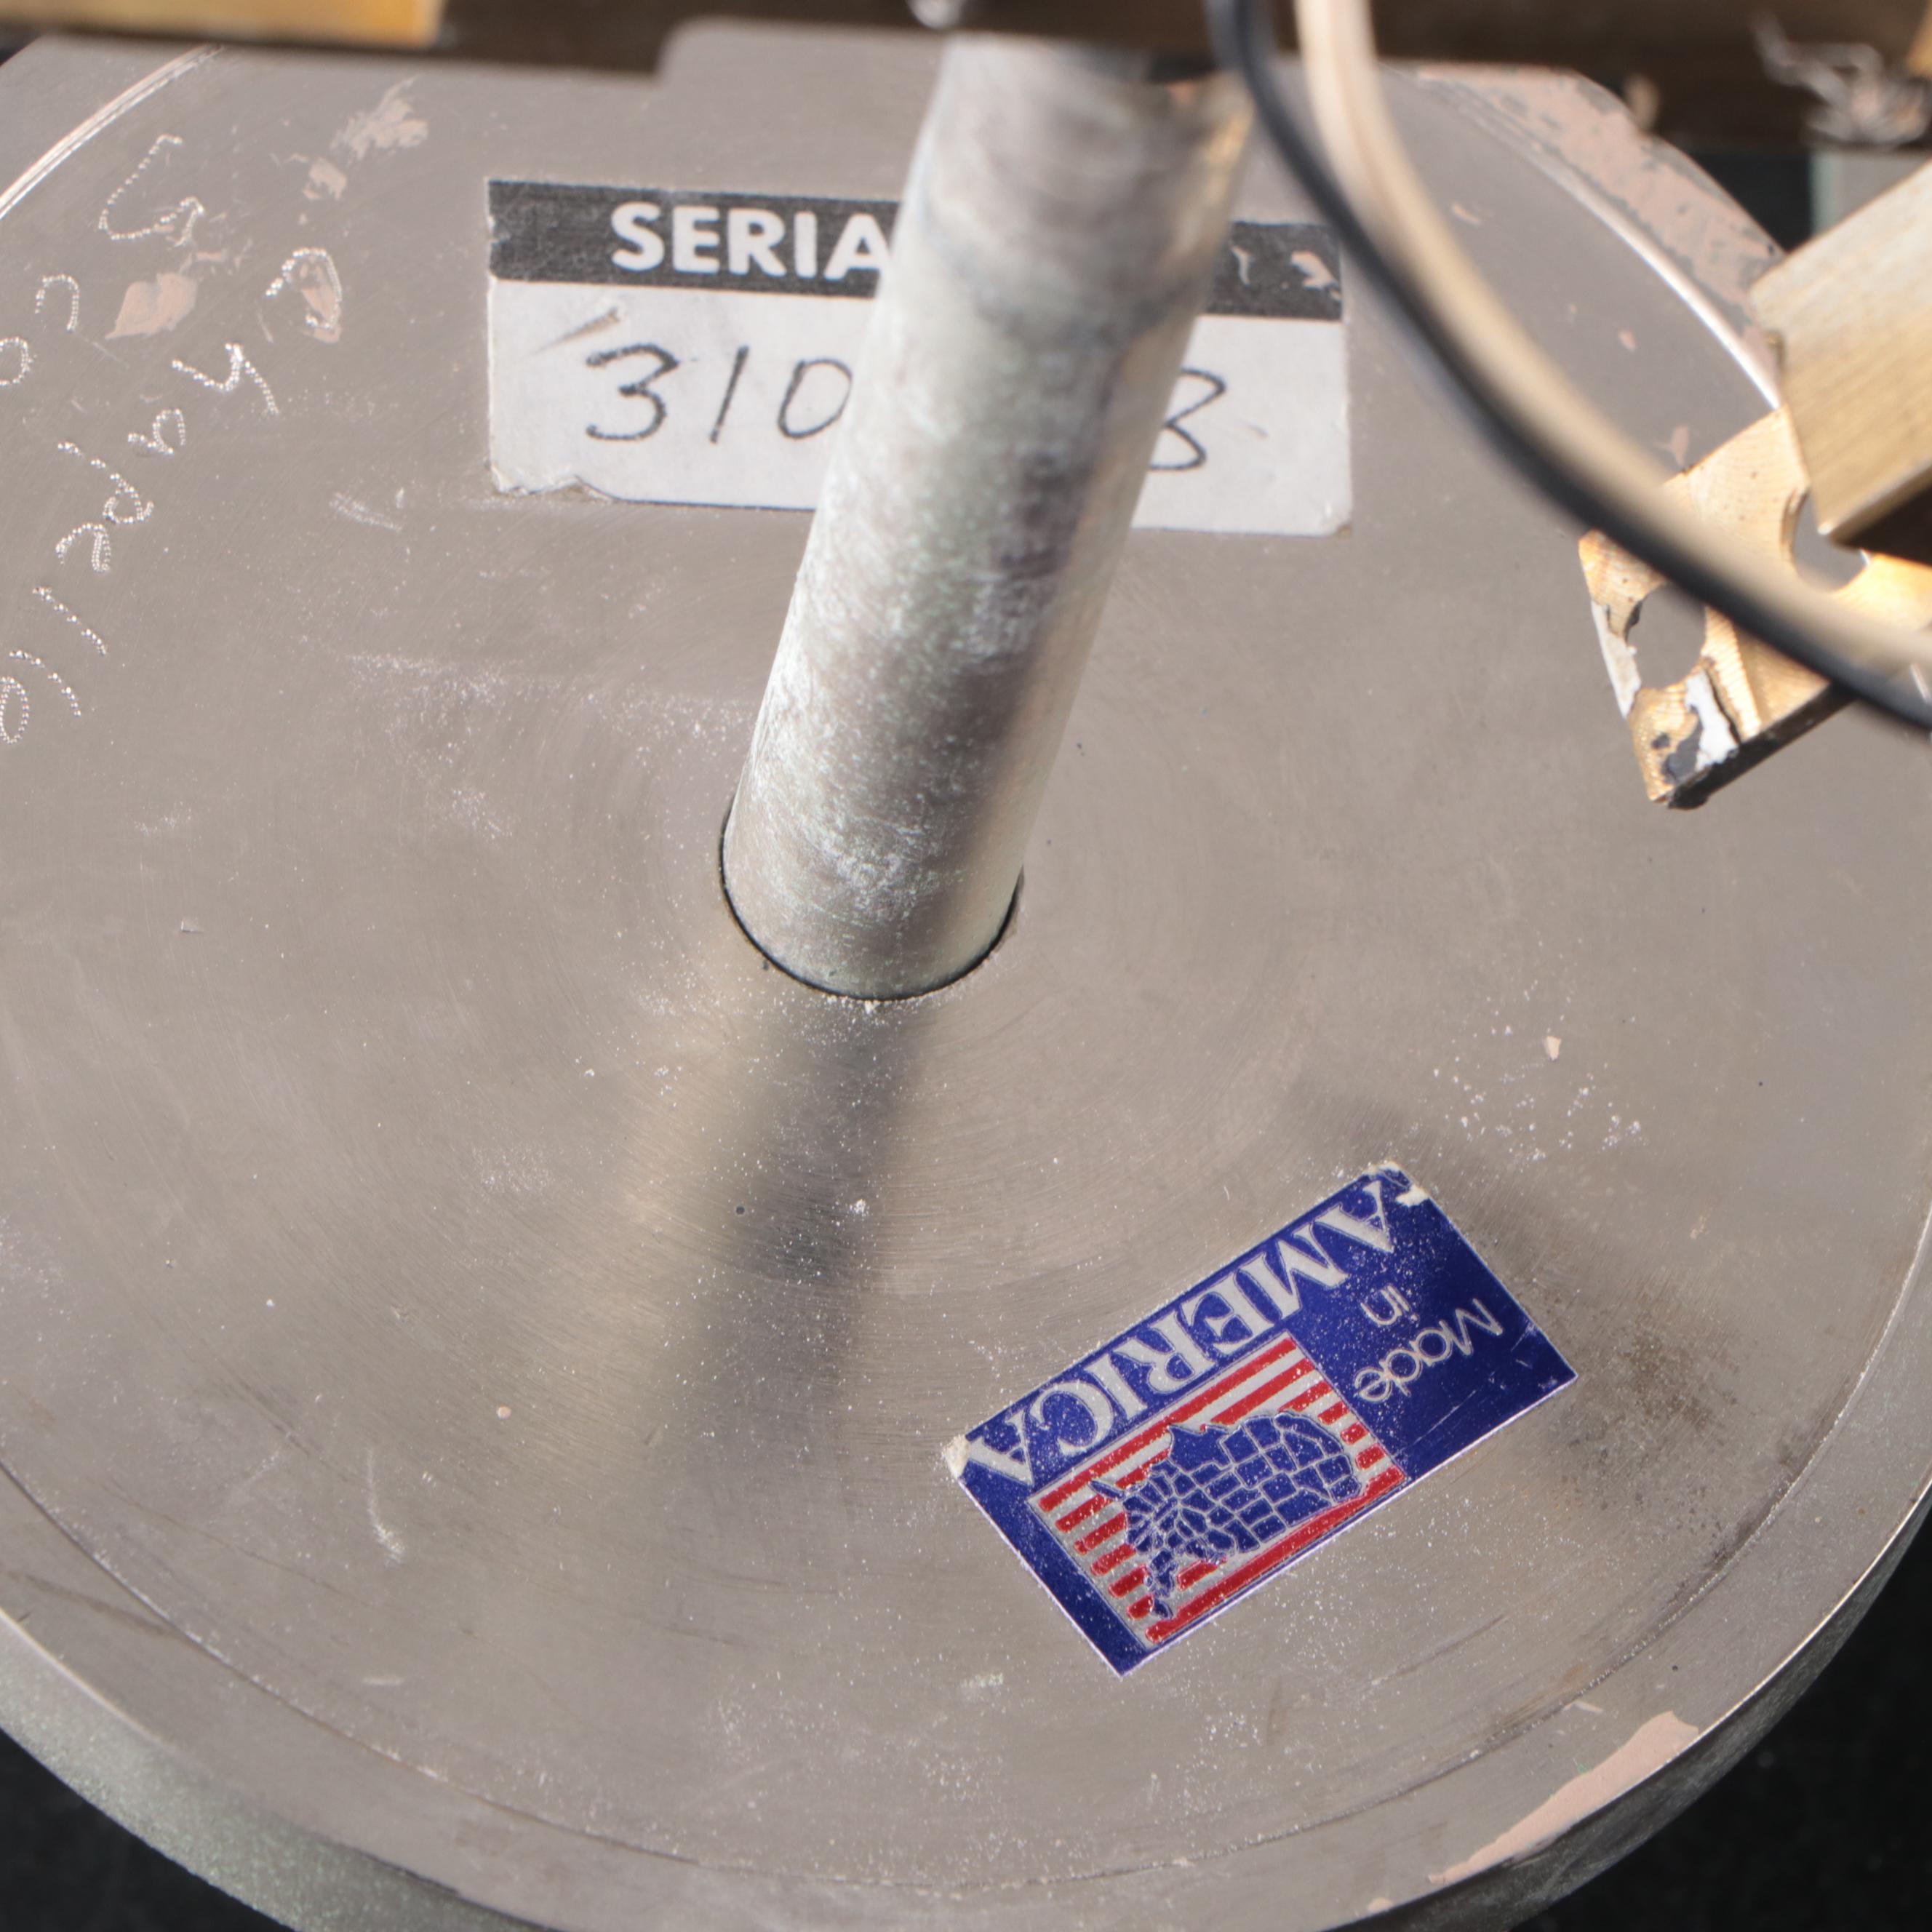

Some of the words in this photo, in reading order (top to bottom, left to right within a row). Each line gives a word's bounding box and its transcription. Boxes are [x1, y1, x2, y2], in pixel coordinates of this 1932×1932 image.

[966, 1180, 1395, 1486] AMERICA
[1354, 1298, 1504, 1402] Made
[1360, 1284, 1418, 1325] in
